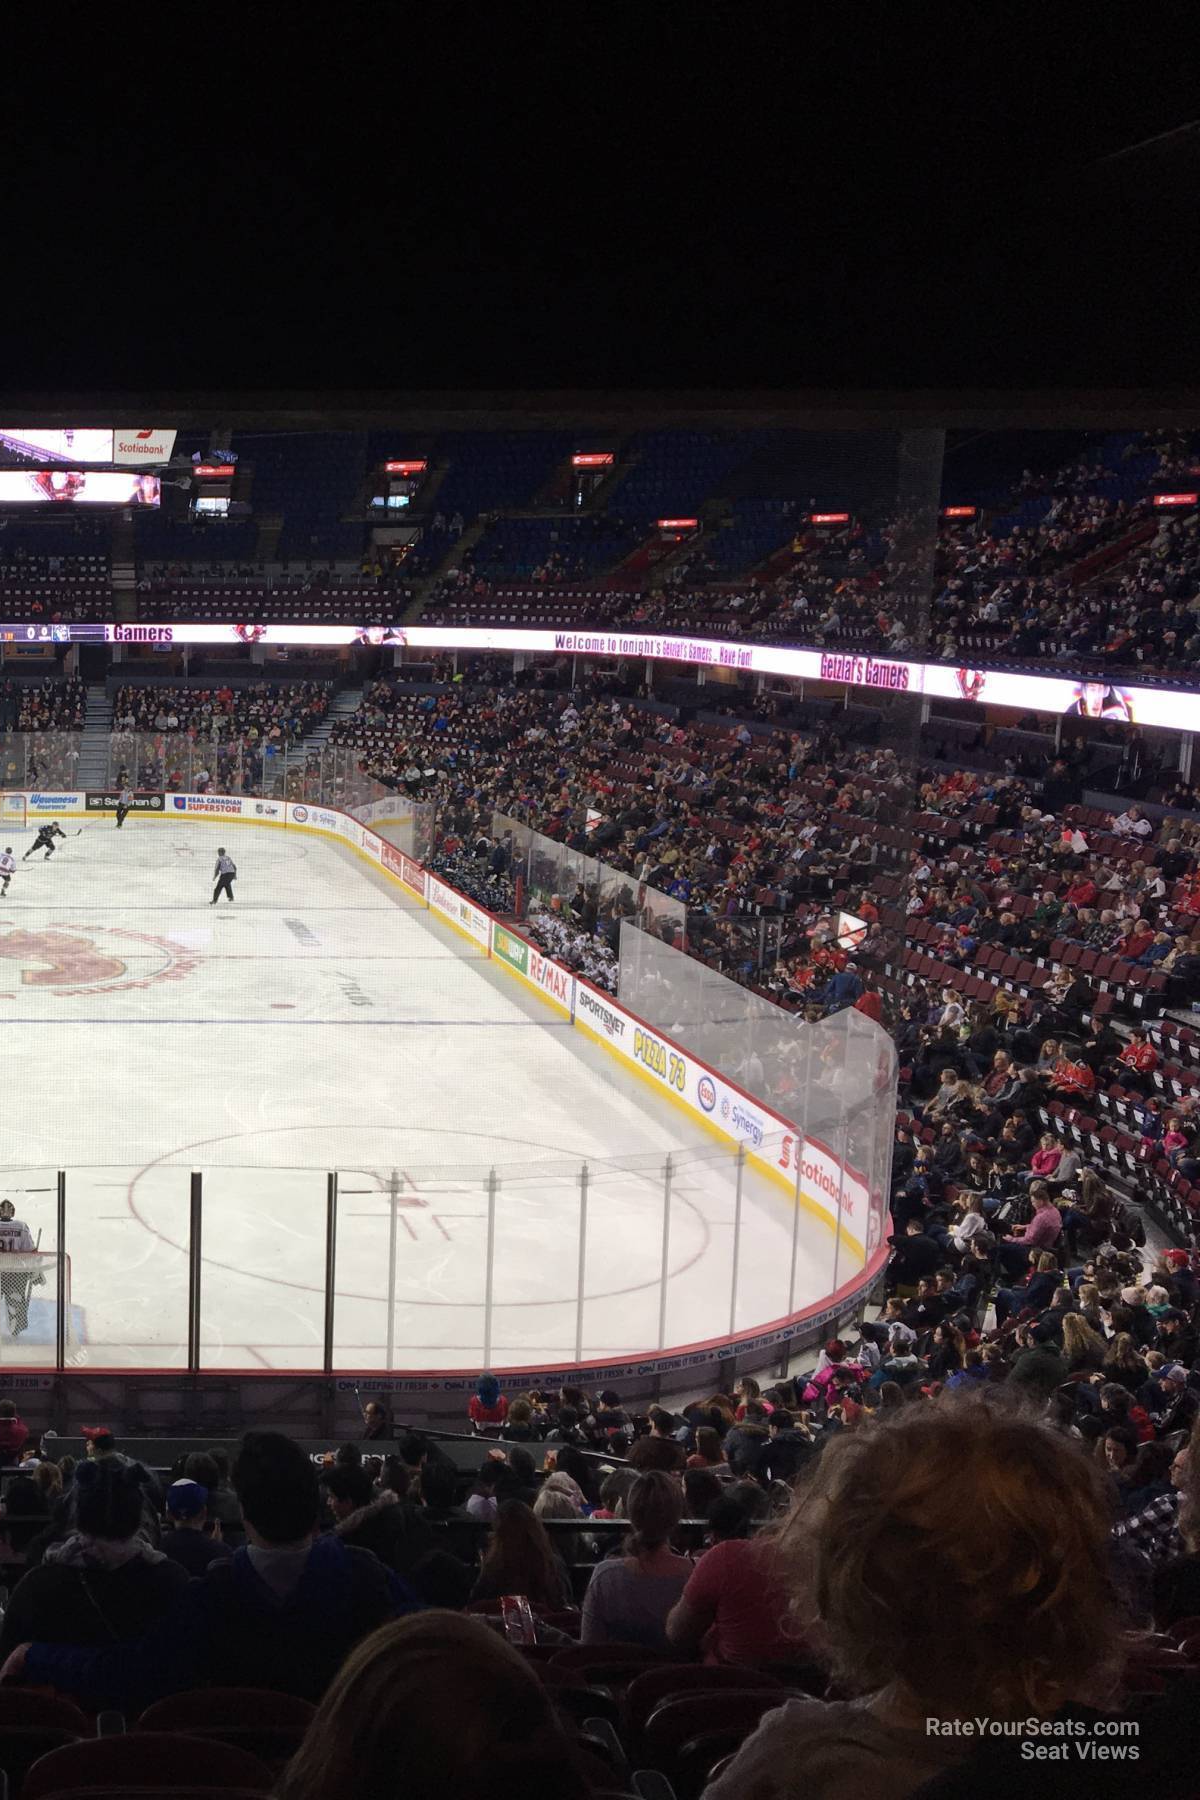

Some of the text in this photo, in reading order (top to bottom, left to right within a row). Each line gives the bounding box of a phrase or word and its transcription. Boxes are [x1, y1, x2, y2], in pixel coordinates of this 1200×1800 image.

[119, 442, 164, 454] Scotiabank
[113, 624, 173, 641] Gamers
[554, 635, 605, 653] Welcome
[607, 638, 616, 651] to
[619, 639, 661, 656] tonight's
[719, 646, 737, 665] Have
[820, 652, 909, 689] Getzlaf's Gamers
[30, 794, 77, 804] Wawanesa
[188, 803, 241, 813] SUPERSTORE
[206, 797, 242, 807] CANADIAN
[530, 953, 568, 1002] RE/MAX
[579, 991, 626, 1037] SPORTSNET
[633, 1027, 687, 1092] PIZZA 73
[732, 1105, 763, 1147] Synergy
